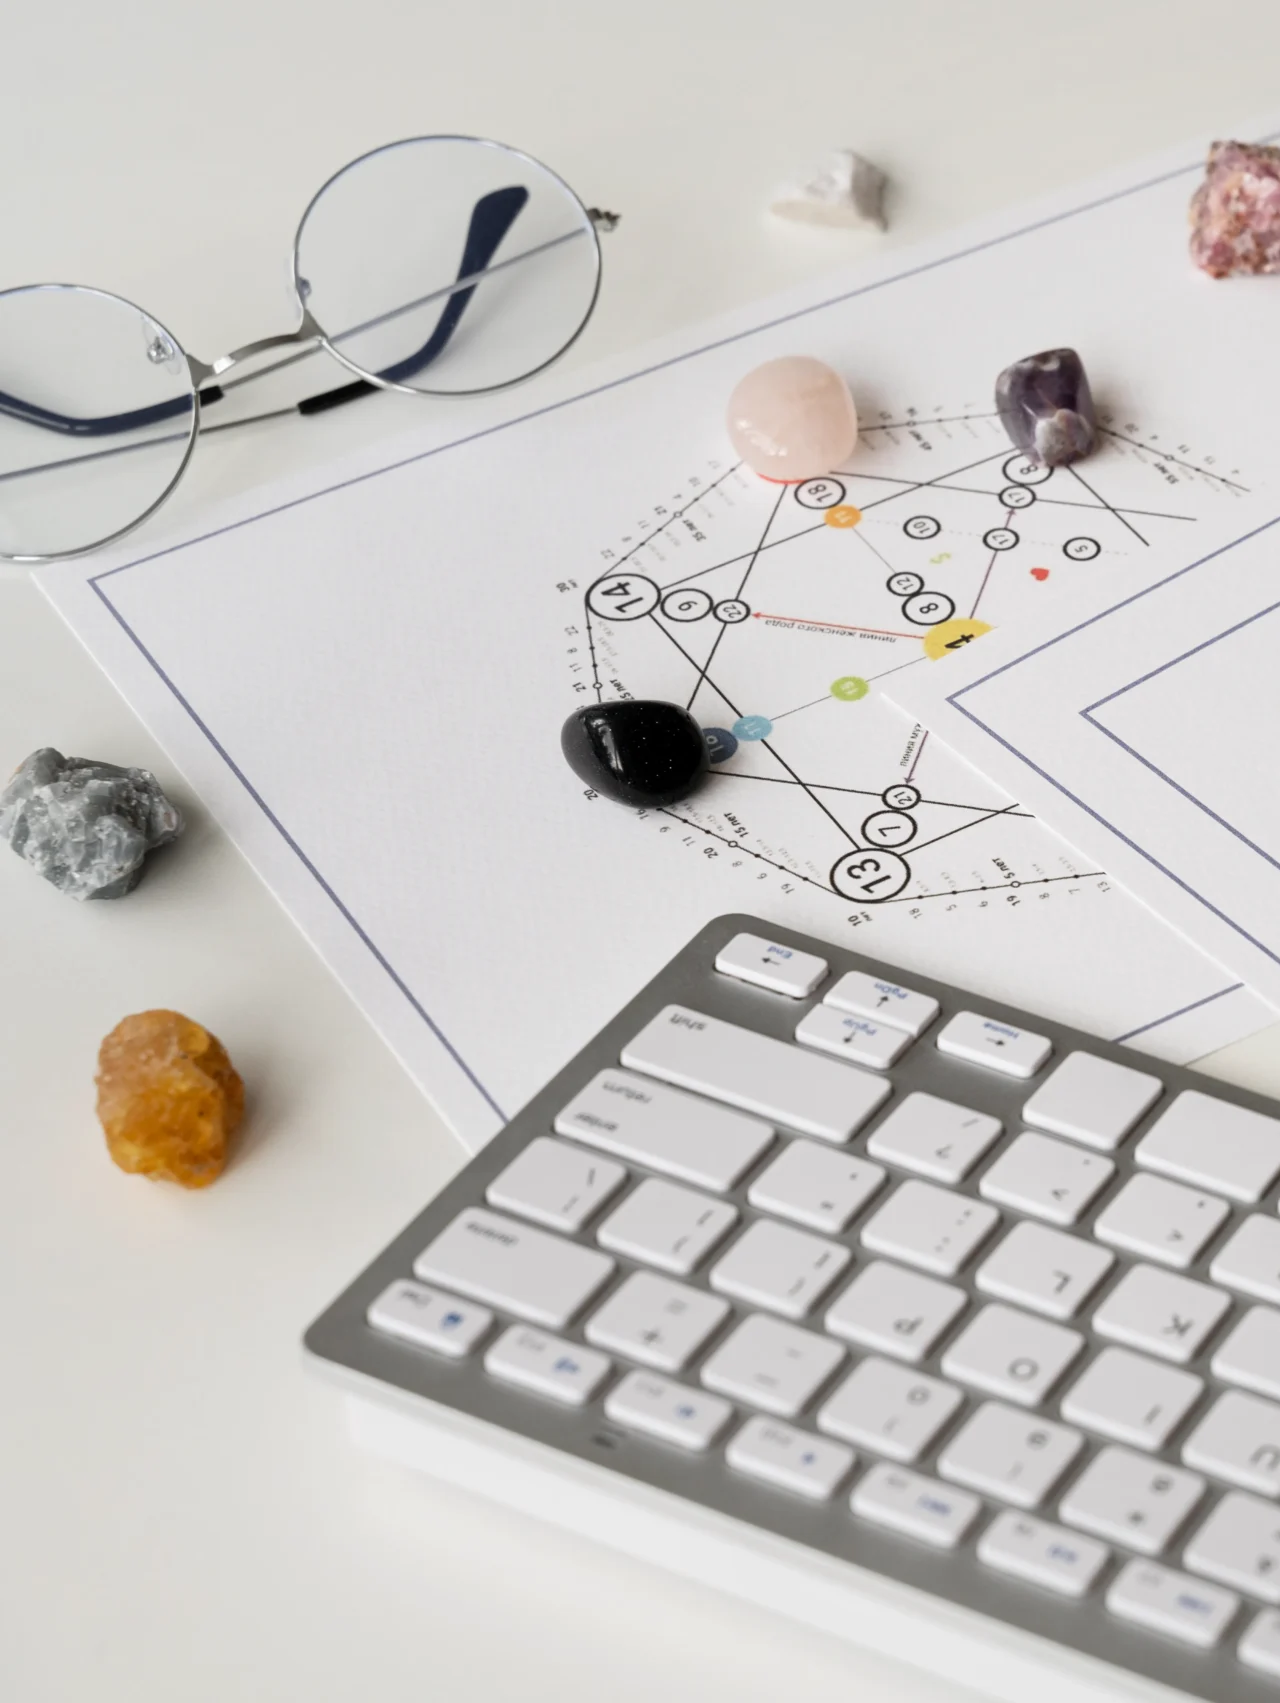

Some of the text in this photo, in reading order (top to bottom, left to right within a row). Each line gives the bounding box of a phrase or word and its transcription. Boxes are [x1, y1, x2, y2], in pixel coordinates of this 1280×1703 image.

[808, 485, 833, 502] 18
[1008, 491, 1025, 503] 17
[913, 522, 930, 534] 10
[993, 533, 1009, 545] 17
[1075, 544, 1088, 554] 5
[897, 578, 914, 590] 12
[601, 582, 643, 613] 14
[678, 601, 697, 611] 9
[723, 604, 741, 619] 22
[919, 603, 939, 614] 8
[765, 619, 897, 644] линия женского рода
[894, 791, 912, 805] 21
[723, 812, 749, 838] 15 лет
[878, 826, 901, 836] 7
[704, 847, 718, 858] 20
[846, 858, 891, 894] 13
[992, 857, 1016, 880] 5 лет
[1006, 895, 1020, 906] 19
[767, 945, 792, 960] End
[874, 982, 908, 999] PgDn
[669, 1013, 707, 1032] shift
[842, 1018, 878, 1037] PgUp
[984, 1021, 1019, 1041] Home
[601, 1080, 652, 1105] return
[1053, 1271, 1070, 1292] L
[894, 1318, 922, 1336] P
[1163, 1315, 1192, 1336] K
